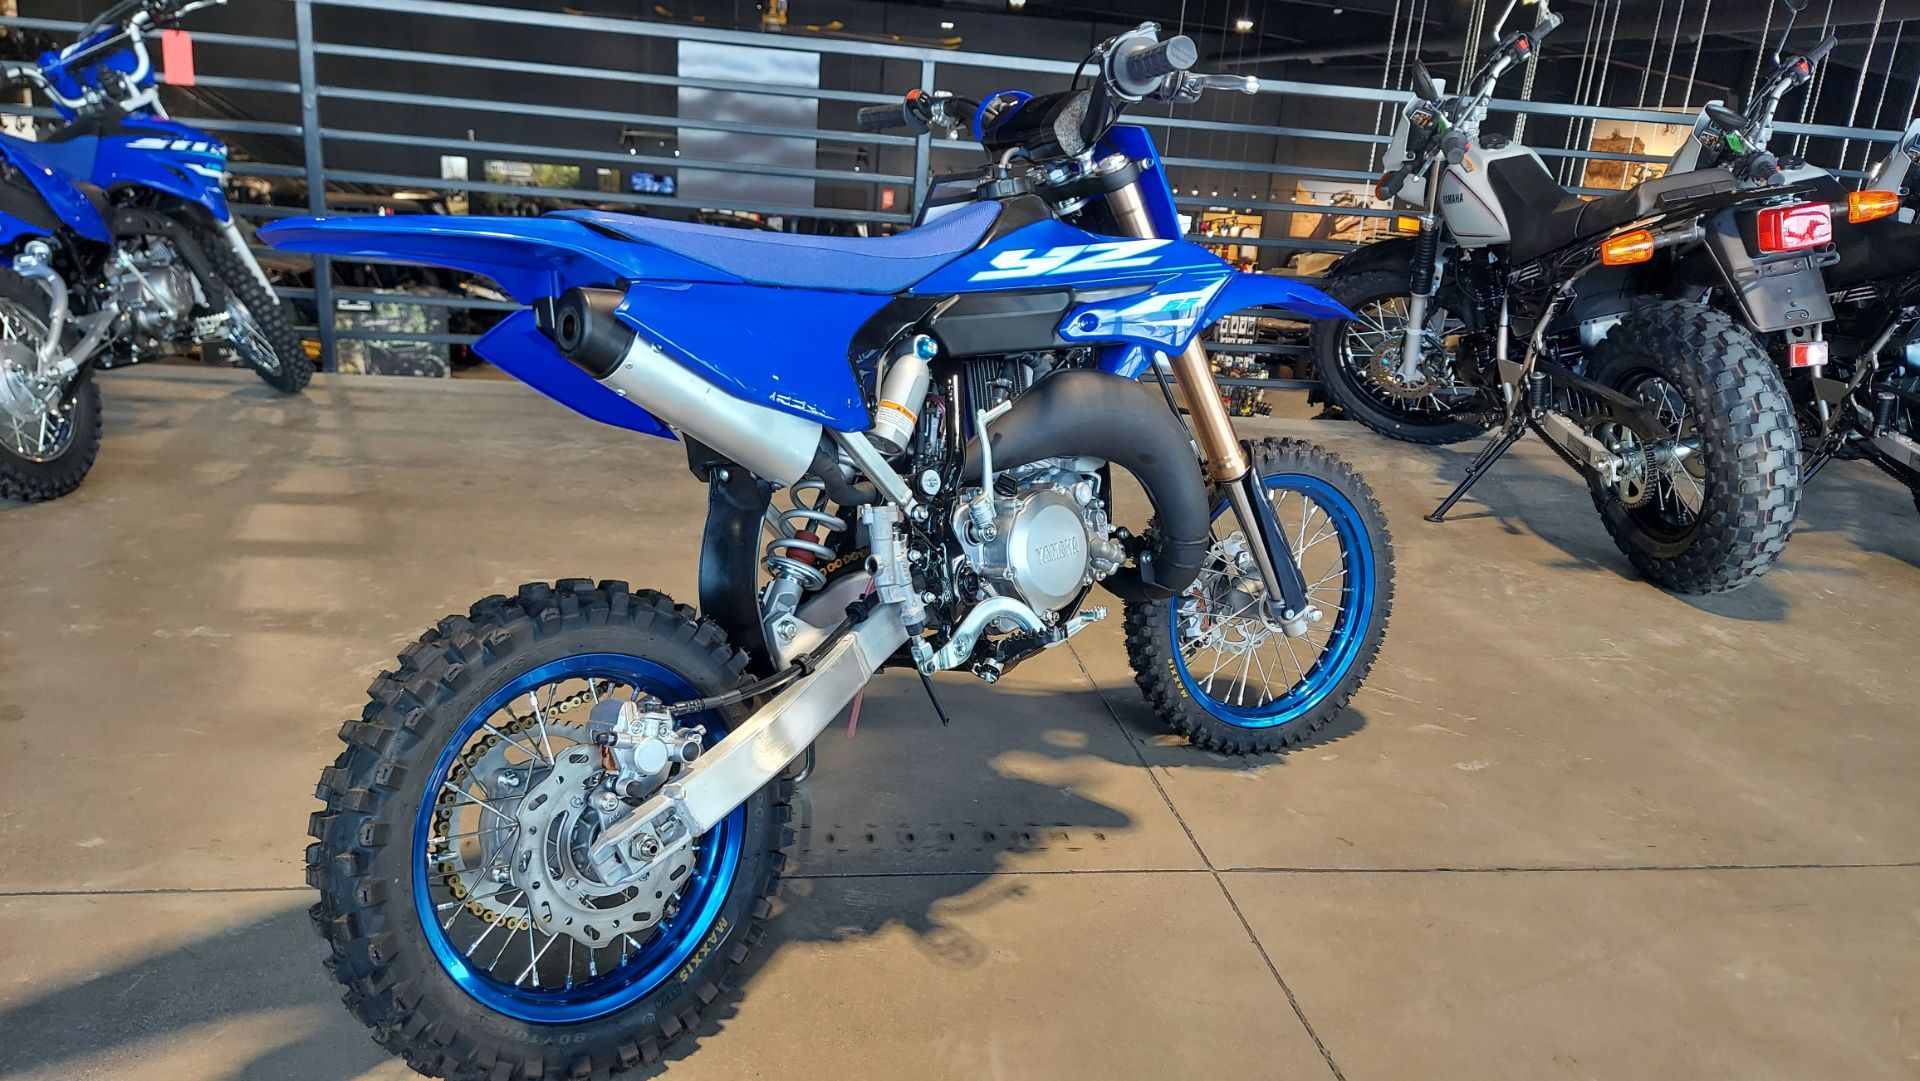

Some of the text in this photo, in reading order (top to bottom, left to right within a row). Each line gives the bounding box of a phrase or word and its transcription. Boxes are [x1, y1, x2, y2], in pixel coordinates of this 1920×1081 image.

[1442, 193, 1464, 205] YAMAHA
[967, 239, 1175, 282] YZ
[1036, 536, 1080, 565] YAMAHA
[1167, 658, 1188, 698] MAXXIS
[679, 916, 729, 982] MAXXIS
